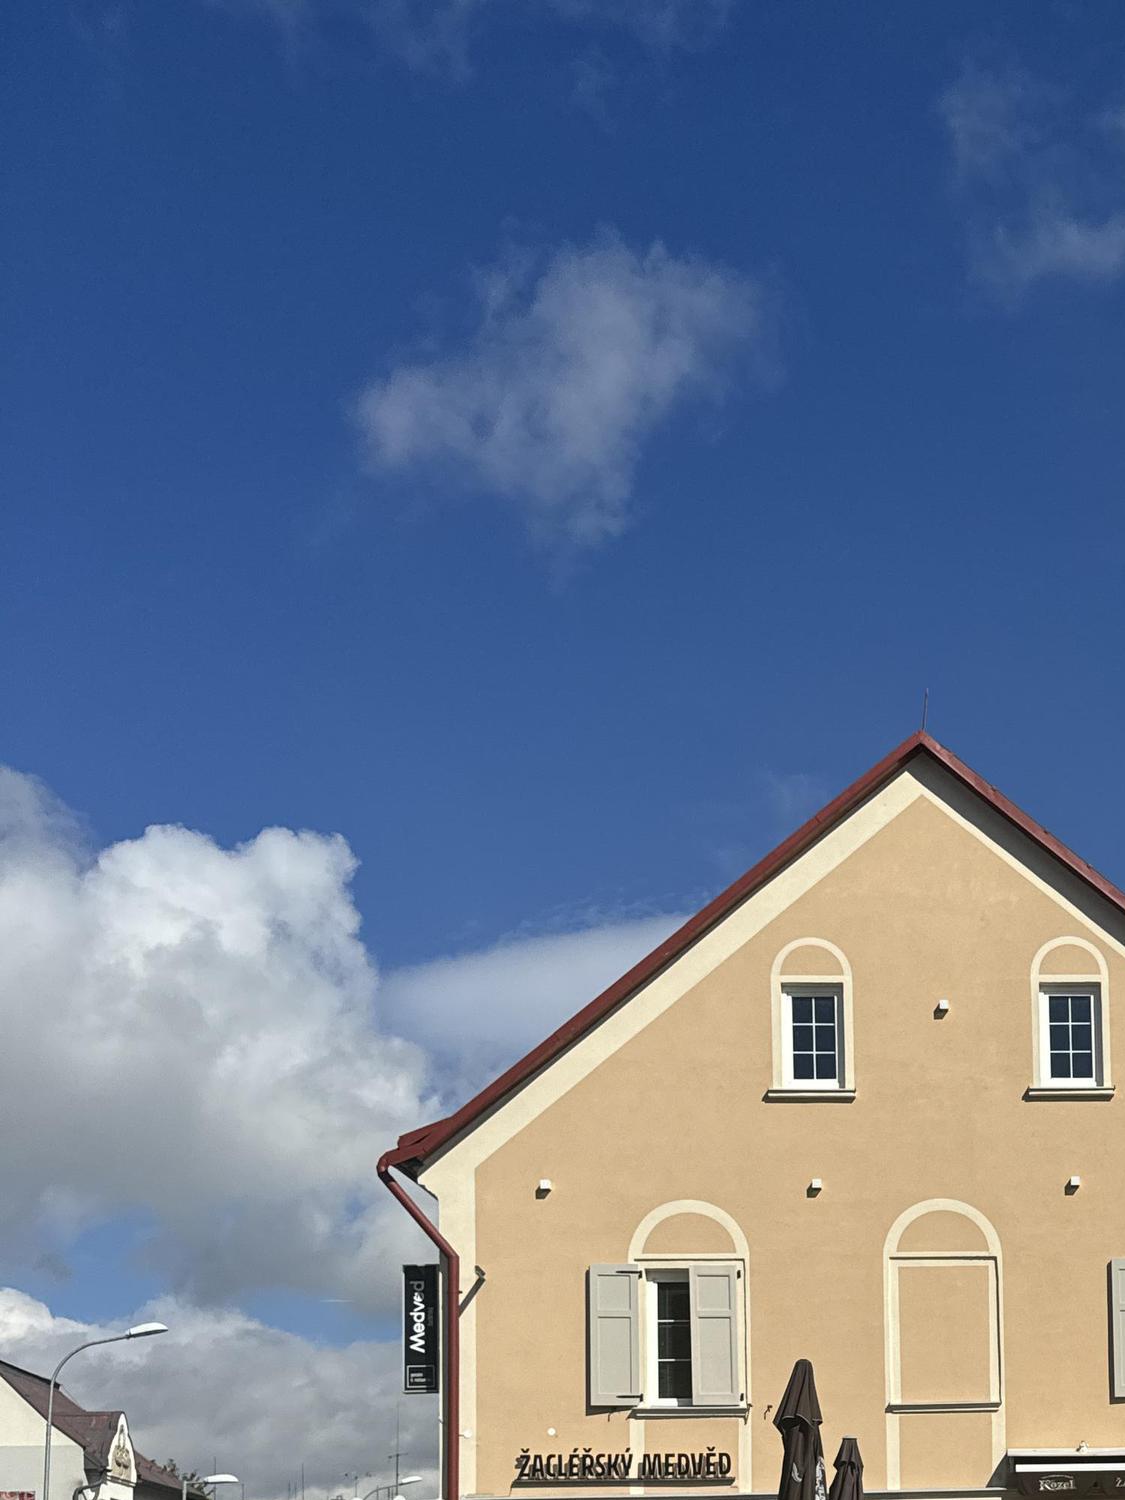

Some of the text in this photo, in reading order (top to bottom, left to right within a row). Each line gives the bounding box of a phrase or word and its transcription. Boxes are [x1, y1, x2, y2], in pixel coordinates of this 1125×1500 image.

[518, 1446, 732, 1478] ŽACLÉŘSKÝ MEDVĚD
[1039, 1478, 1076, 1491] Kozel
